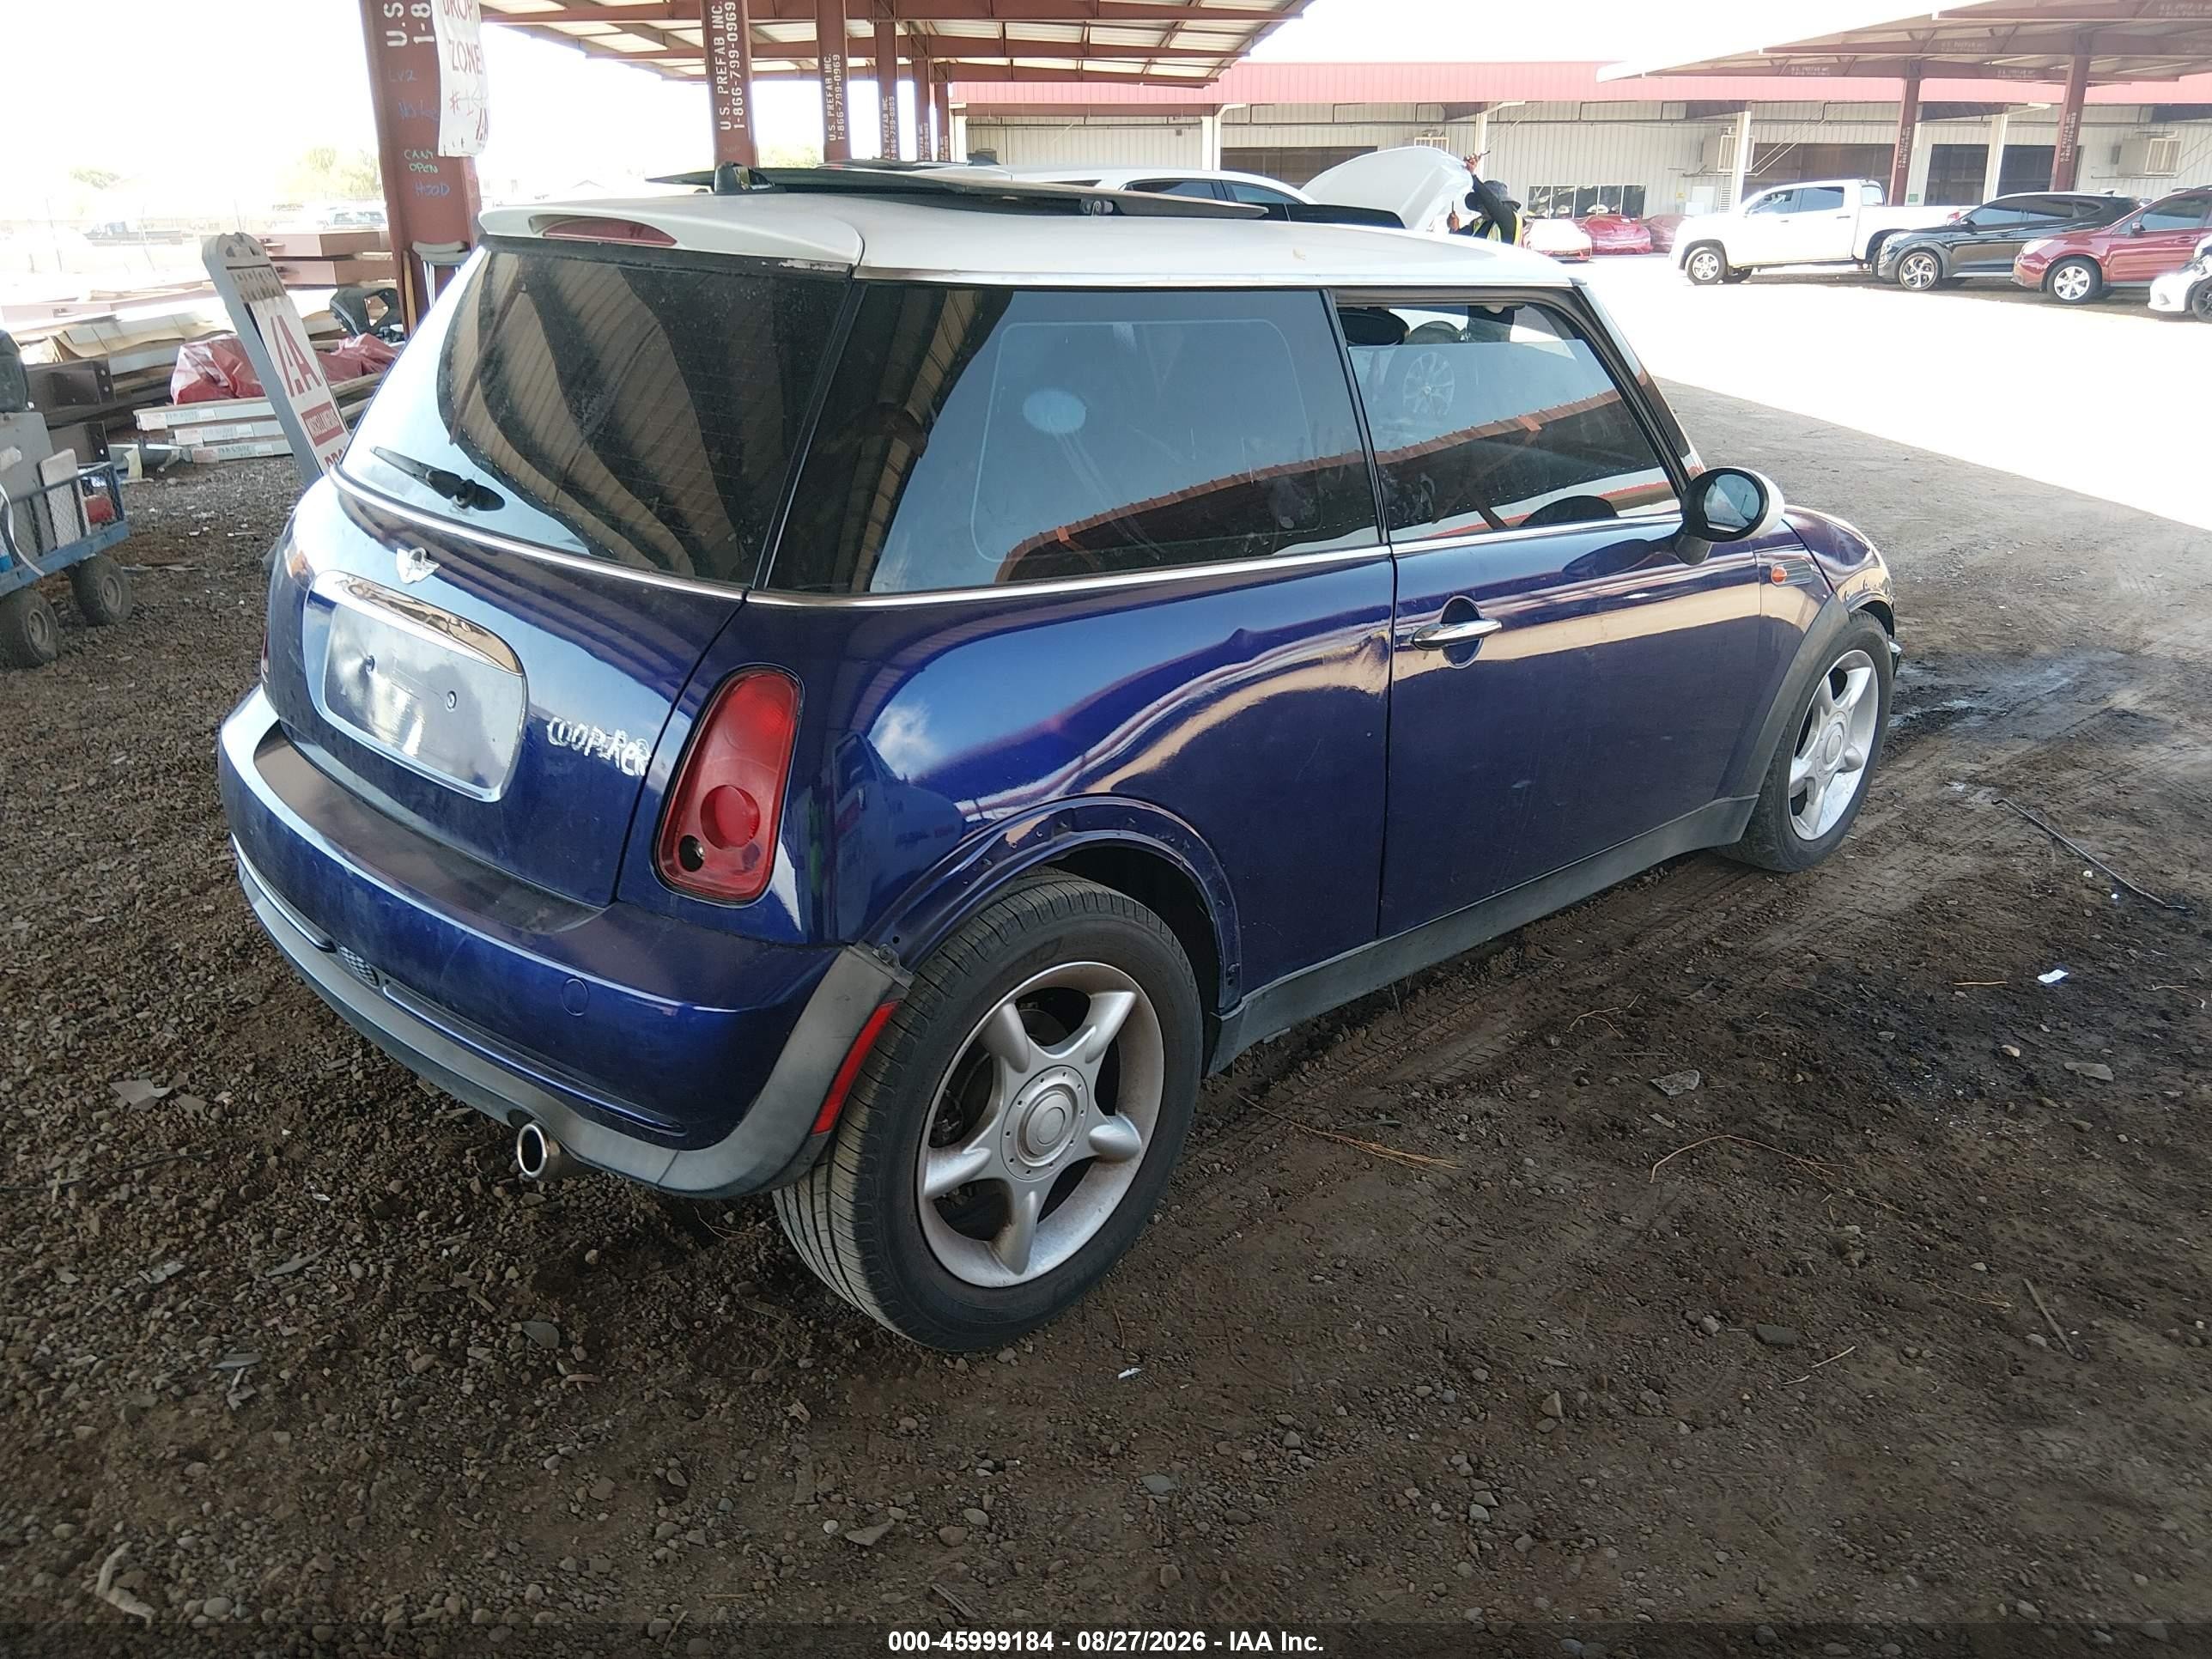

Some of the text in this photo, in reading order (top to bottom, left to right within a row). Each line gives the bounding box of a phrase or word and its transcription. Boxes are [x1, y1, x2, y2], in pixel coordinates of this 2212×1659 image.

[711, 1, 725, 29] INC.
[448, 39, 483, 76] ZONE
[714, 36, 729, 94] PREFAB
[724, 2, 745, 129] 1-866-799-0969
[825, 77, 835, 117] PREFAB
[832, 54, 845, 140] 1-866-799-0969
[719, 102, 732, 131] U.S.
[409, 161, 439, 174] OPEN
